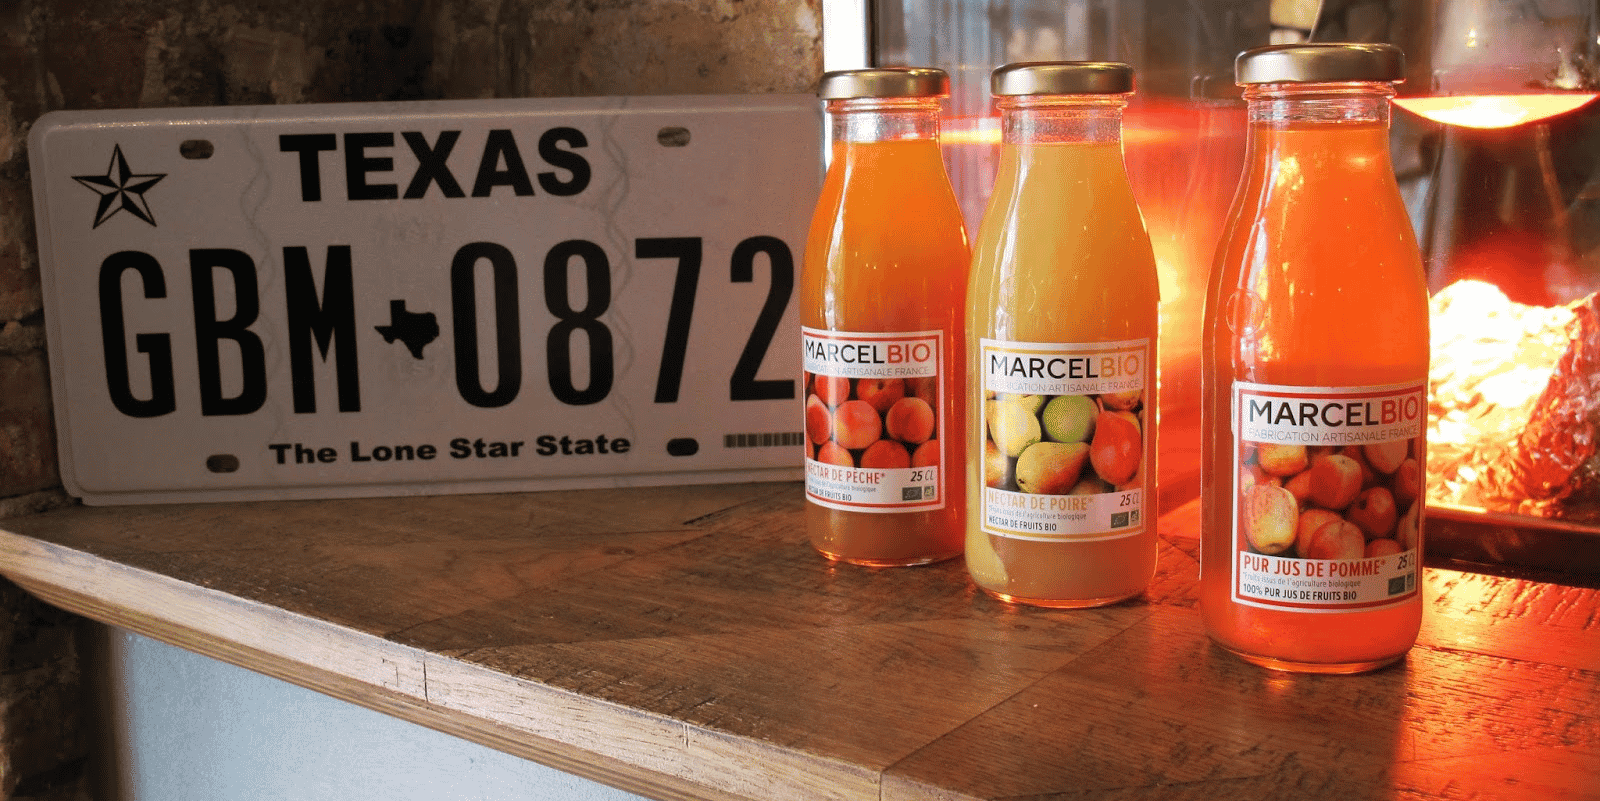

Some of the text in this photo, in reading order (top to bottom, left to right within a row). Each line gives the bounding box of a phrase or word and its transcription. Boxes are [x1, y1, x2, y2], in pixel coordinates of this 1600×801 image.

[279, 126, 591, 202] TEXAS
[98, 235, 796, 419] GBM 0872
[894, 366, 930, 376] FRANCE
[991, 379, 1140, 393] ICATION ARTISANALE FRANCE
[1249, 425, 1418, 442] FABRICATION ARTISANALE FRANCE
[269, 433, 632, 466] The Lone Star State
[832, 469, 843, 482] DE
[910, 471, 923, 483] 25
[842, 493, 852, 501] BIO
[988, 490, 1026, 509] NECTAR
[1030, 496, 1045, 510] DE
[1120, 493, 1131, 507] 25
[989, 515, 1057, 532] NECTAR DE FRUITS BIO
[1243, 554, 1269, 573] PUR
[1273, 559, 1300, 576] JUS
[1306, 561, 1323, 577] DE
[1397, 555, 1408, 570] 25
[1277, 577, 1286, 585] de
[1328, 579, 1361, 590] biologique
[1243, 583, 1357, 601] 100% PUR JUS DE FRUITS BIO
